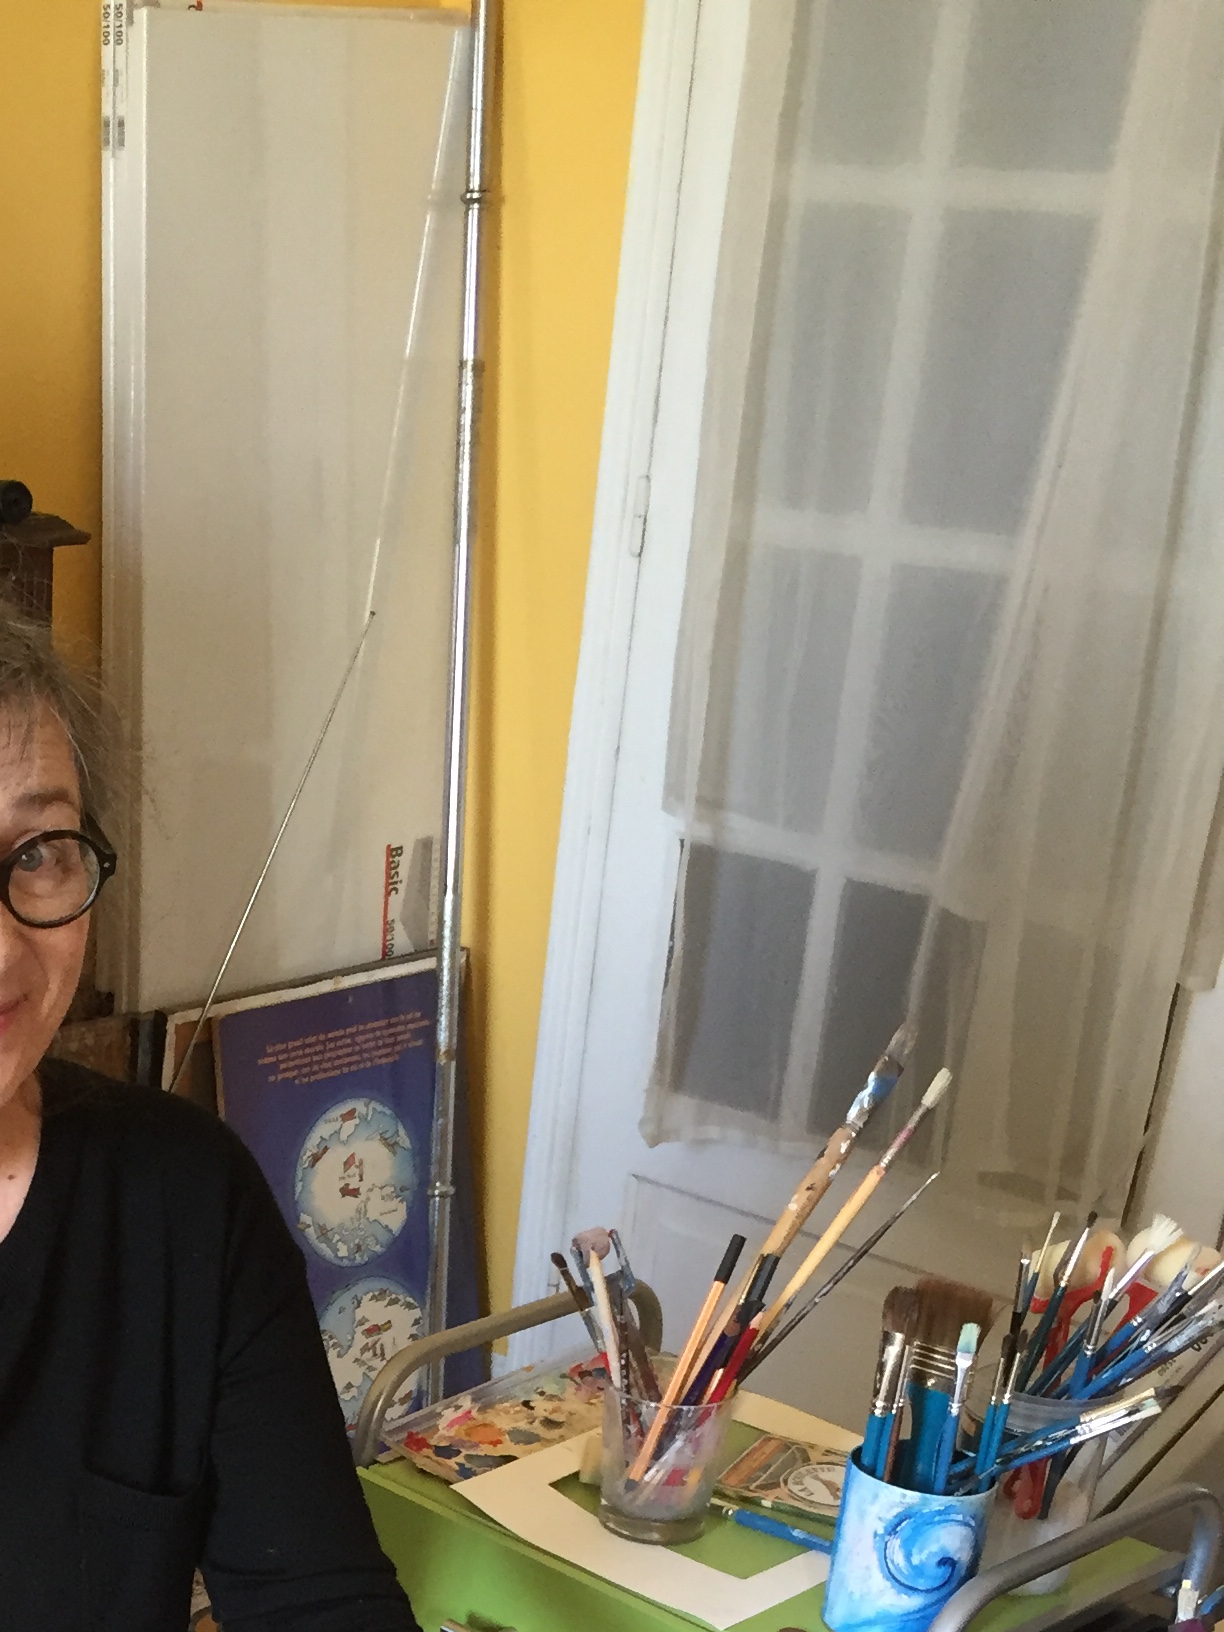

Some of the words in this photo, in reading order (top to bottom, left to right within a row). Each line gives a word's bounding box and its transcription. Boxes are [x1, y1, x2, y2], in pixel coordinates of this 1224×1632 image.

[102, 4, 111, 46] 50/100
[115, 3, 124, 46] 50/100
[388, 845, 404, 896] Basic
